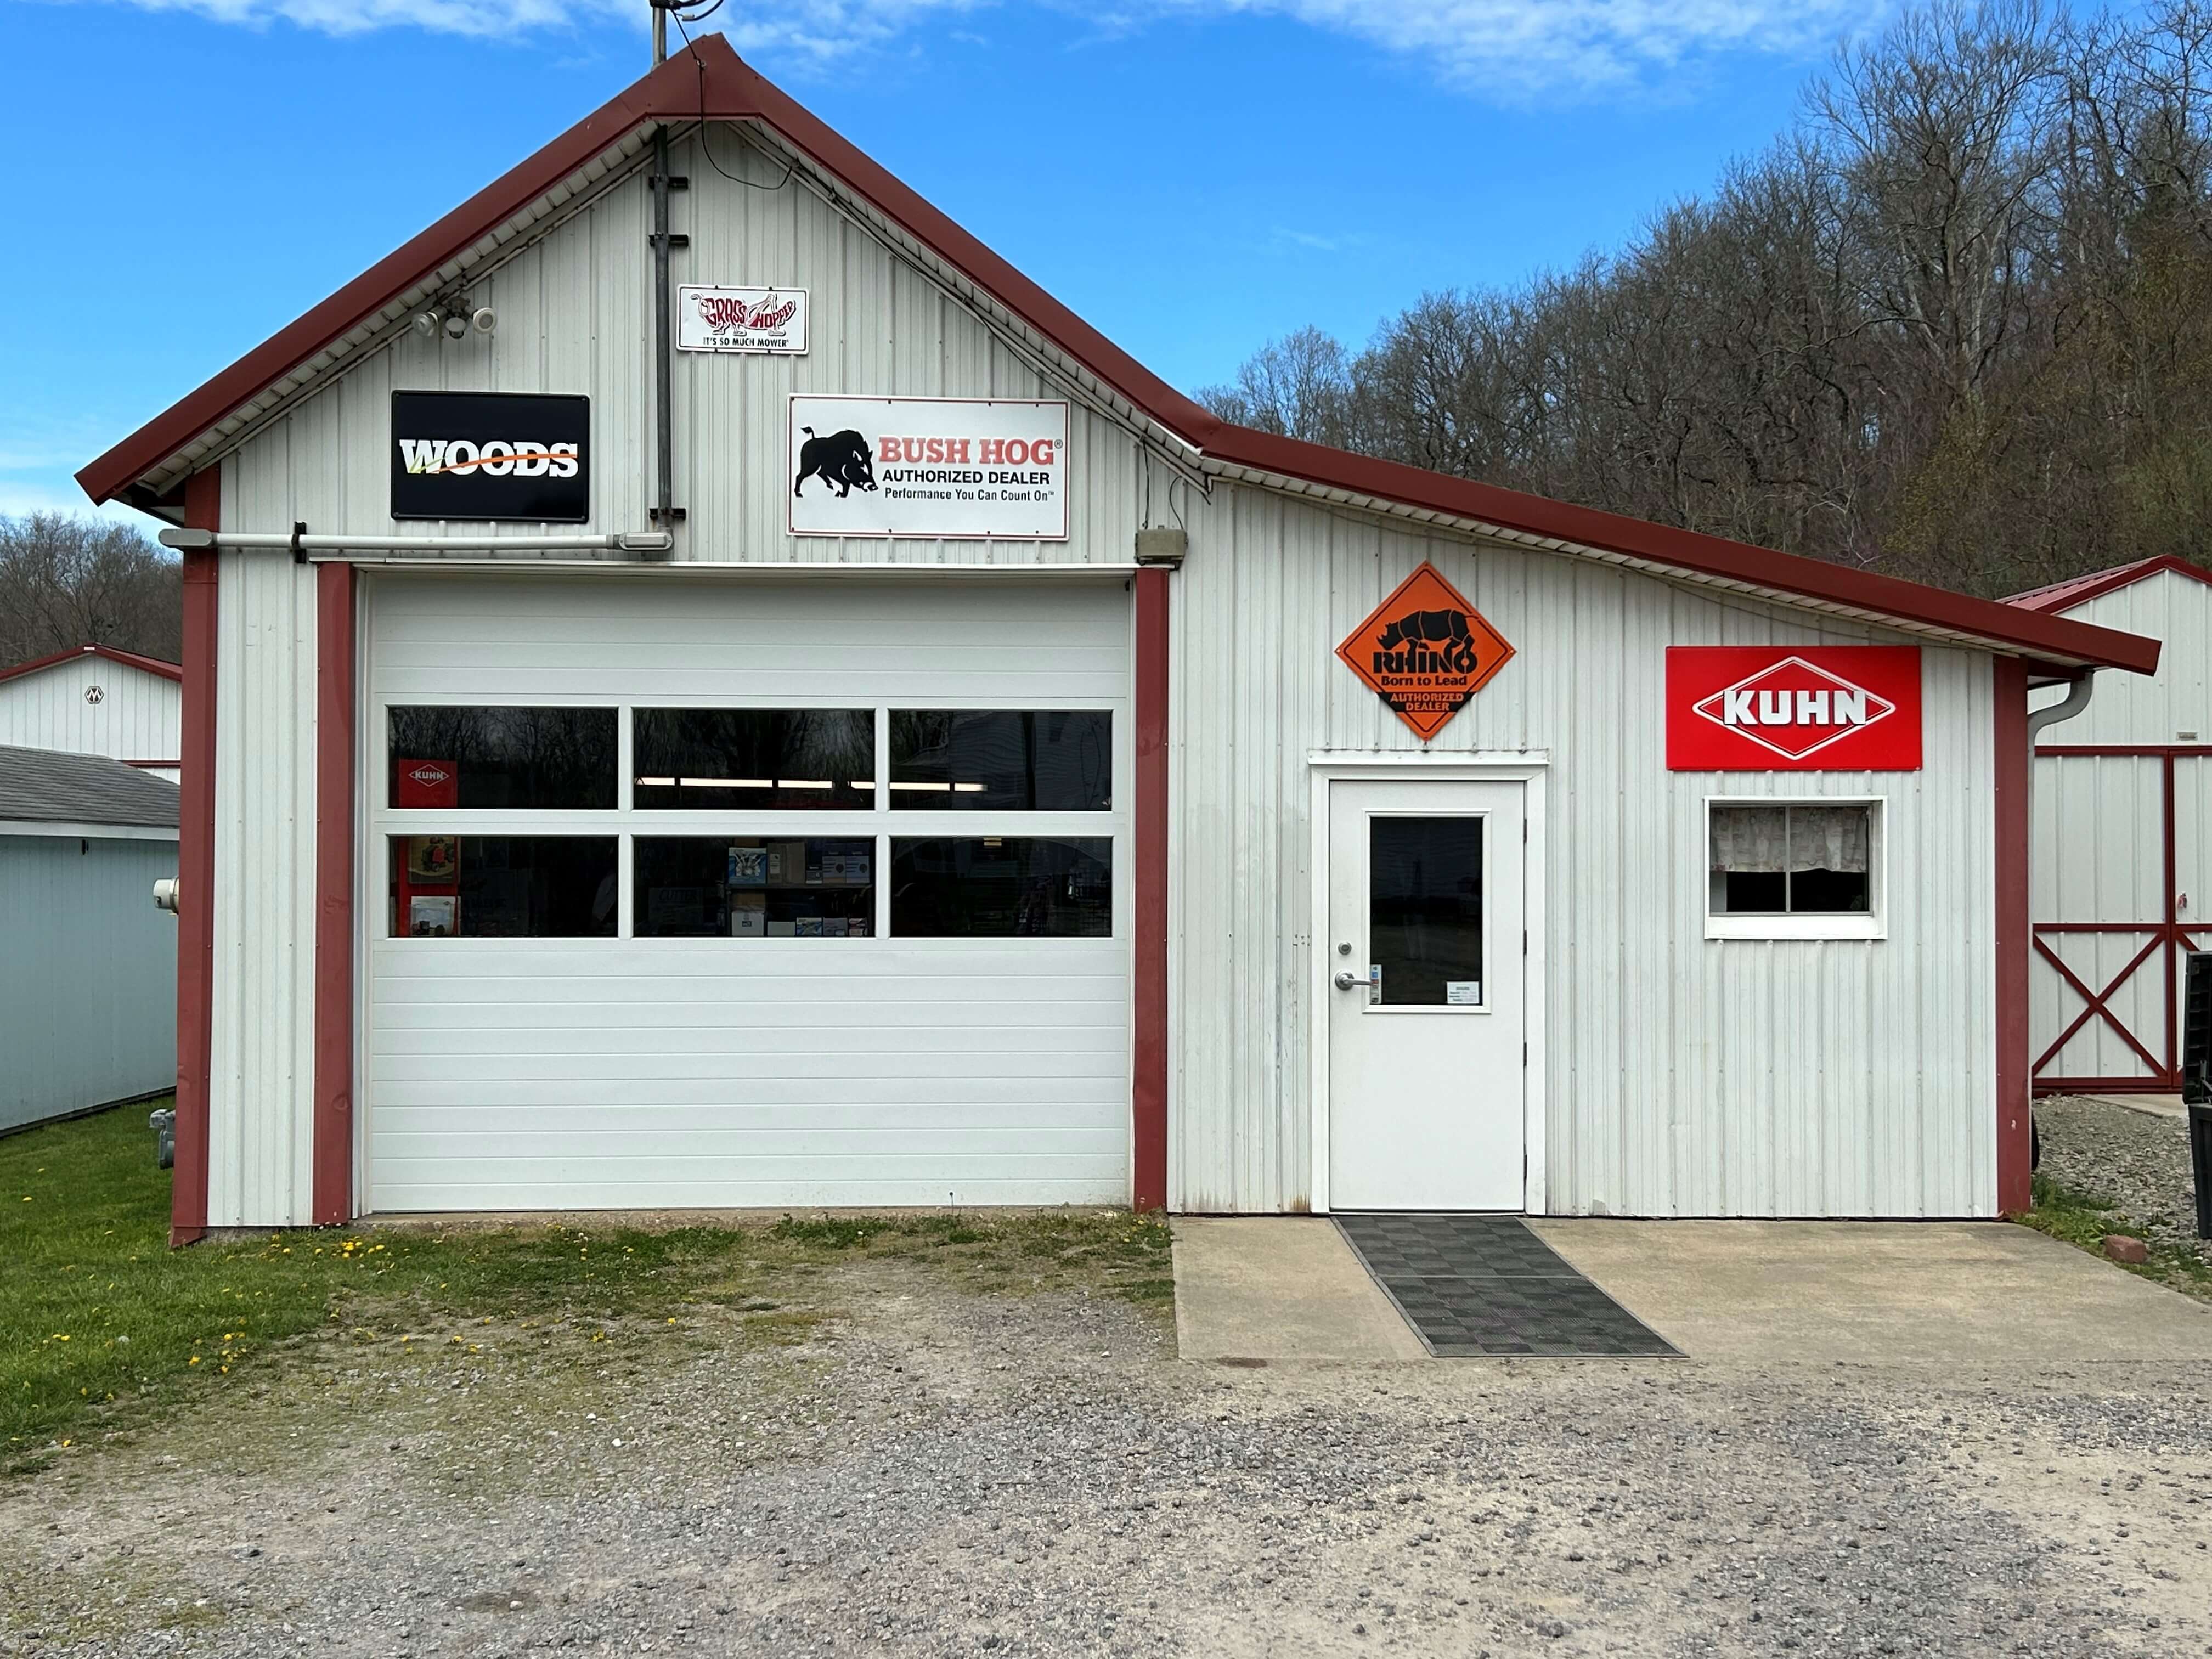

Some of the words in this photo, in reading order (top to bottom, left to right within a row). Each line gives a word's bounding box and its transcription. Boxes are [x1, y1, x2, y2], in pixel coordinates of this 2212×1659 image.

[703, 337, 717, 346] IT'S
[720, 337, 730, 346] SO
[732, 338, 755, 346] MUCH
[878, 436, 970, 464] BUSH
[399, 439, 579, 478] WOODS
[882, 469, 984, 484] AUTHORIZED
[988, 471, 1050, 485] DEALER
[884, 488, 952, 500] Performance
[955, 489, 975, 501] You
[978, 489, 997, 501] Can
[1001, 489, 1031, 501] Count
[1373, 650, 1478, 674] RHINO
[1381, 675, 1413, 686] Born
[1417, 676, 1431, 686] to
[1435, 675, 1468, 686] Lead
[1390, 693, 1464, 703] AUTHORIZED
[1406, 702, 1450, 711] DEALER
[1723, 690, 1867, 725] KUHN
[414, 771, 443, 780] KUHN
